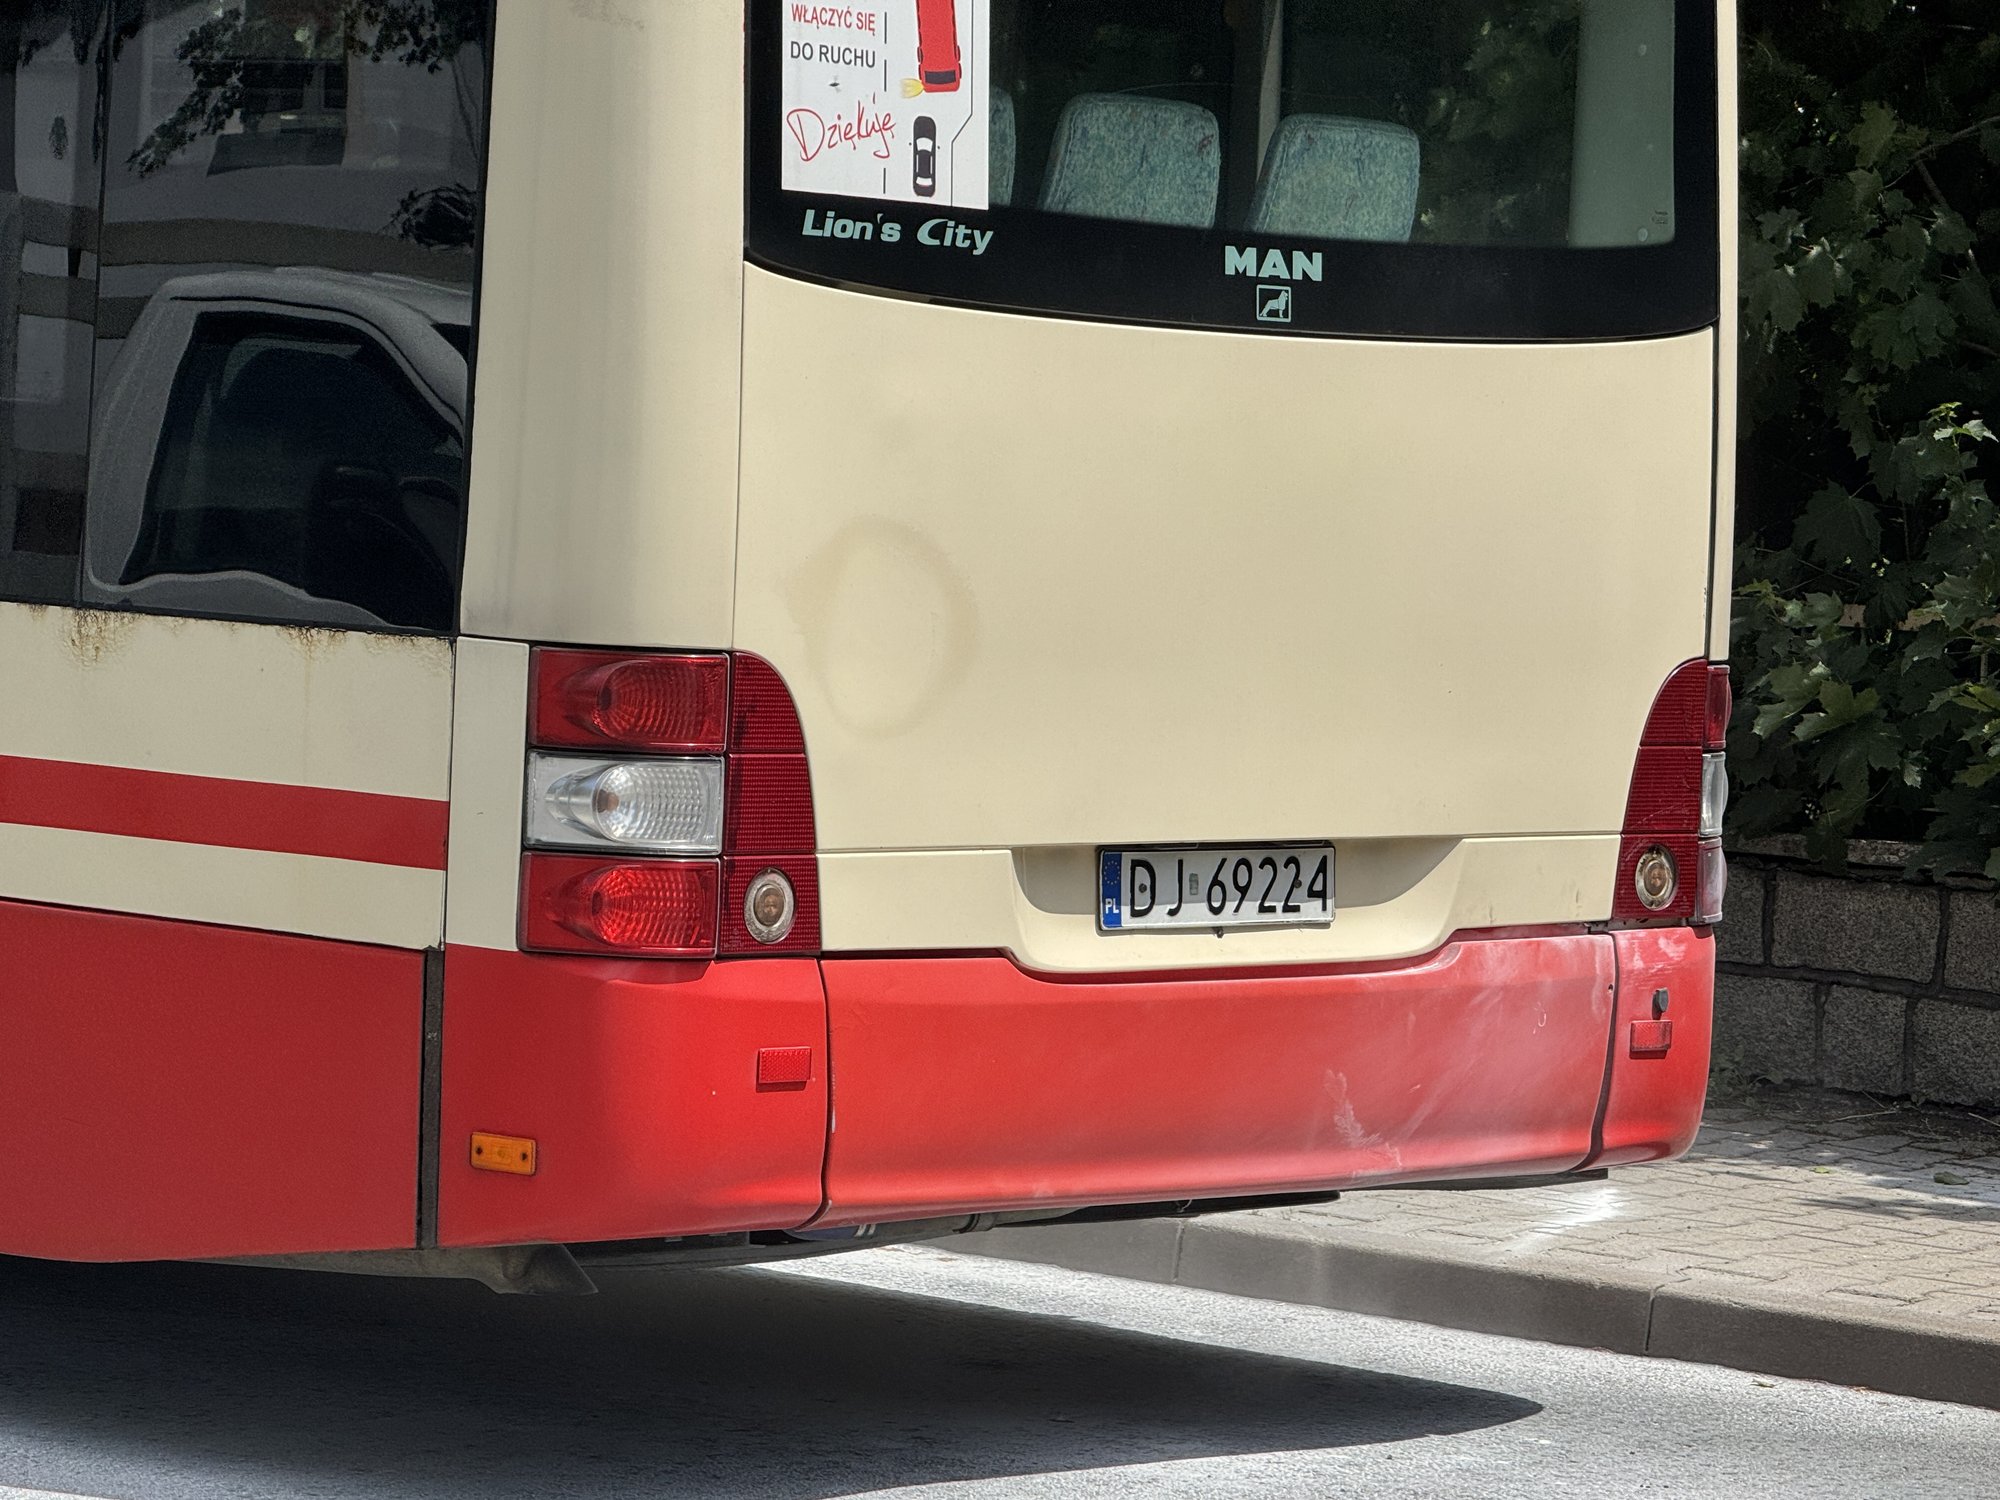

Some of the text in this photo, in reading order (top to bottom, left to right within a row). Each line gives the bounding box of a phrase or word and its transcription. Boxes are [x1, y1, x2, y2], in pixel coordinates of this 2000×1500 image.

[791, 3, 876, 37] WŁĄCZYĆ SIĘ
[790, 40, 876, 68] DO RUCHU
[802, 209, 994, 256] Lion's City
[1224, 245, 1323, 282] MAN
[1130, 854, 1328, 918] DJ 69224
[1105, 897, 1120, 914] PL
